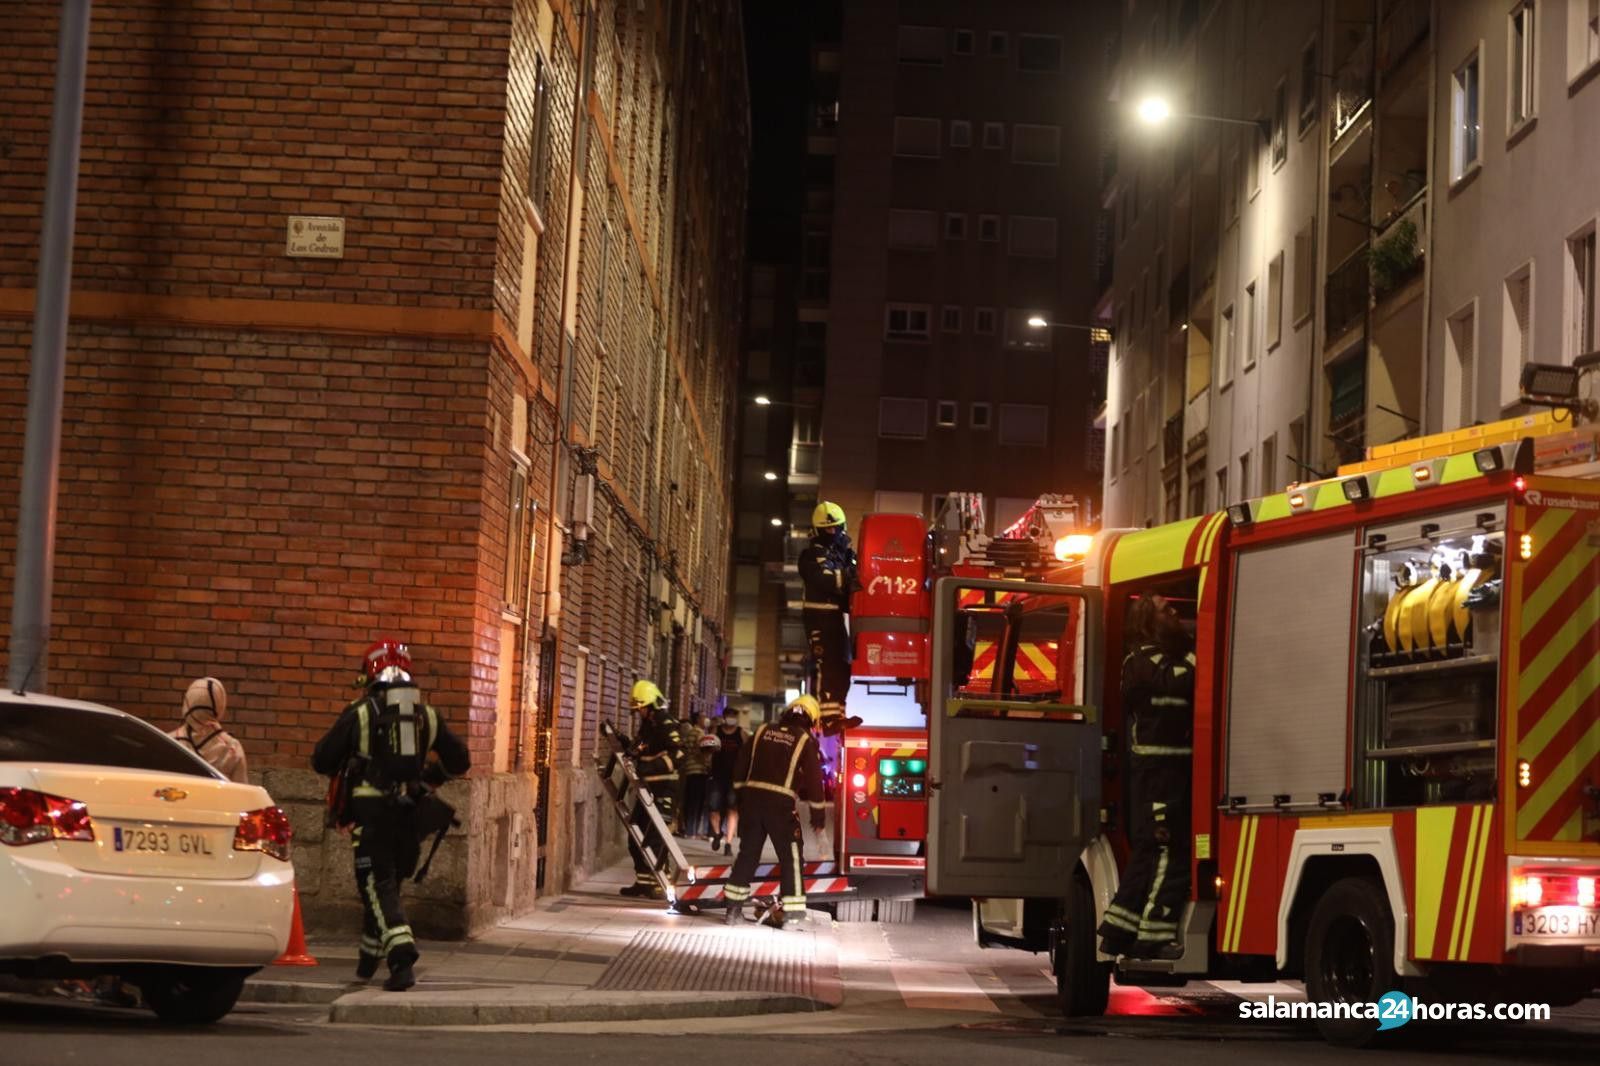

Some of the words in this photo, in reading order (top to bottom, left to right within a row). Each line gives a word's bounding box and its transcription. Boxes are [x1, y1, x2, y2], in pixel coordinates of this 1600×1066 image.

[309, 222, 340, 232] Avenida
[316, 233, 327, 242] de
[308, 242, 339, 253] Cedros
[124, 829, 169, 851] 7293
[179, 833, 212, 855] GVL
[1526, 913, 1570, 934] 3203
